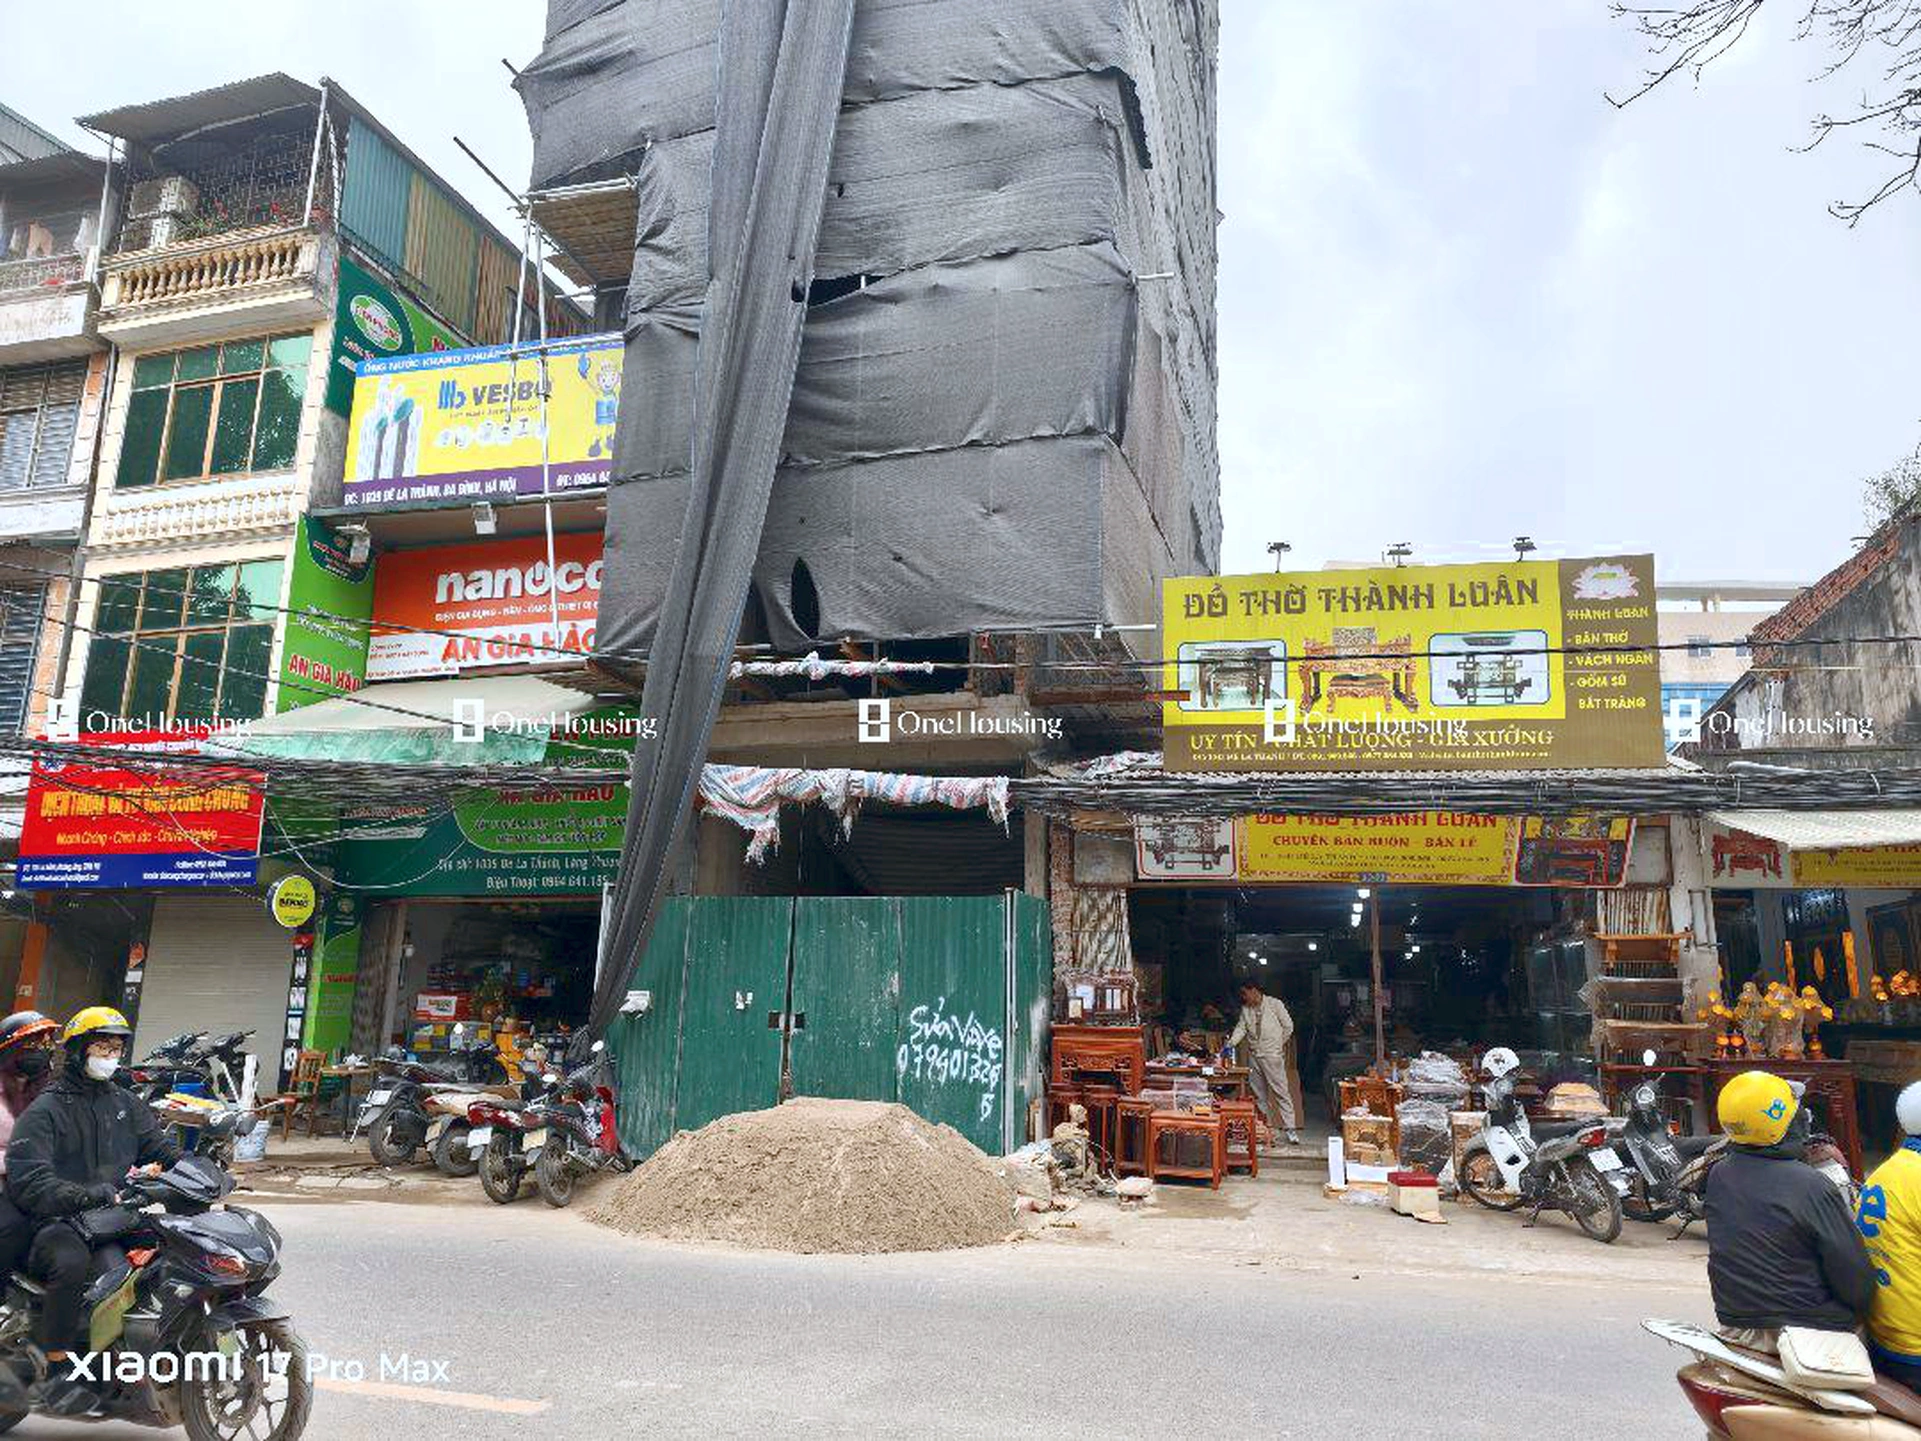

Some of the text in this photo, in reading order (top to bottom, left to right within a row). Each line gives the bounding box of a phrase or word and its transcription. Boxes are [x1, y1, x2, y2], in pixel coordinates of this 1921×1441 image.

[1184, 574, 1539, 619] ĐỒ THỜ THÀNH LUÂN
[442, 637, 482, 662] AN
[288, 653, 310, 678] AN
[312, 661, 333, 686] GIA
[1191, 734, 1217, 750] UY
[1221, 730, 1257, 749] TÍN
